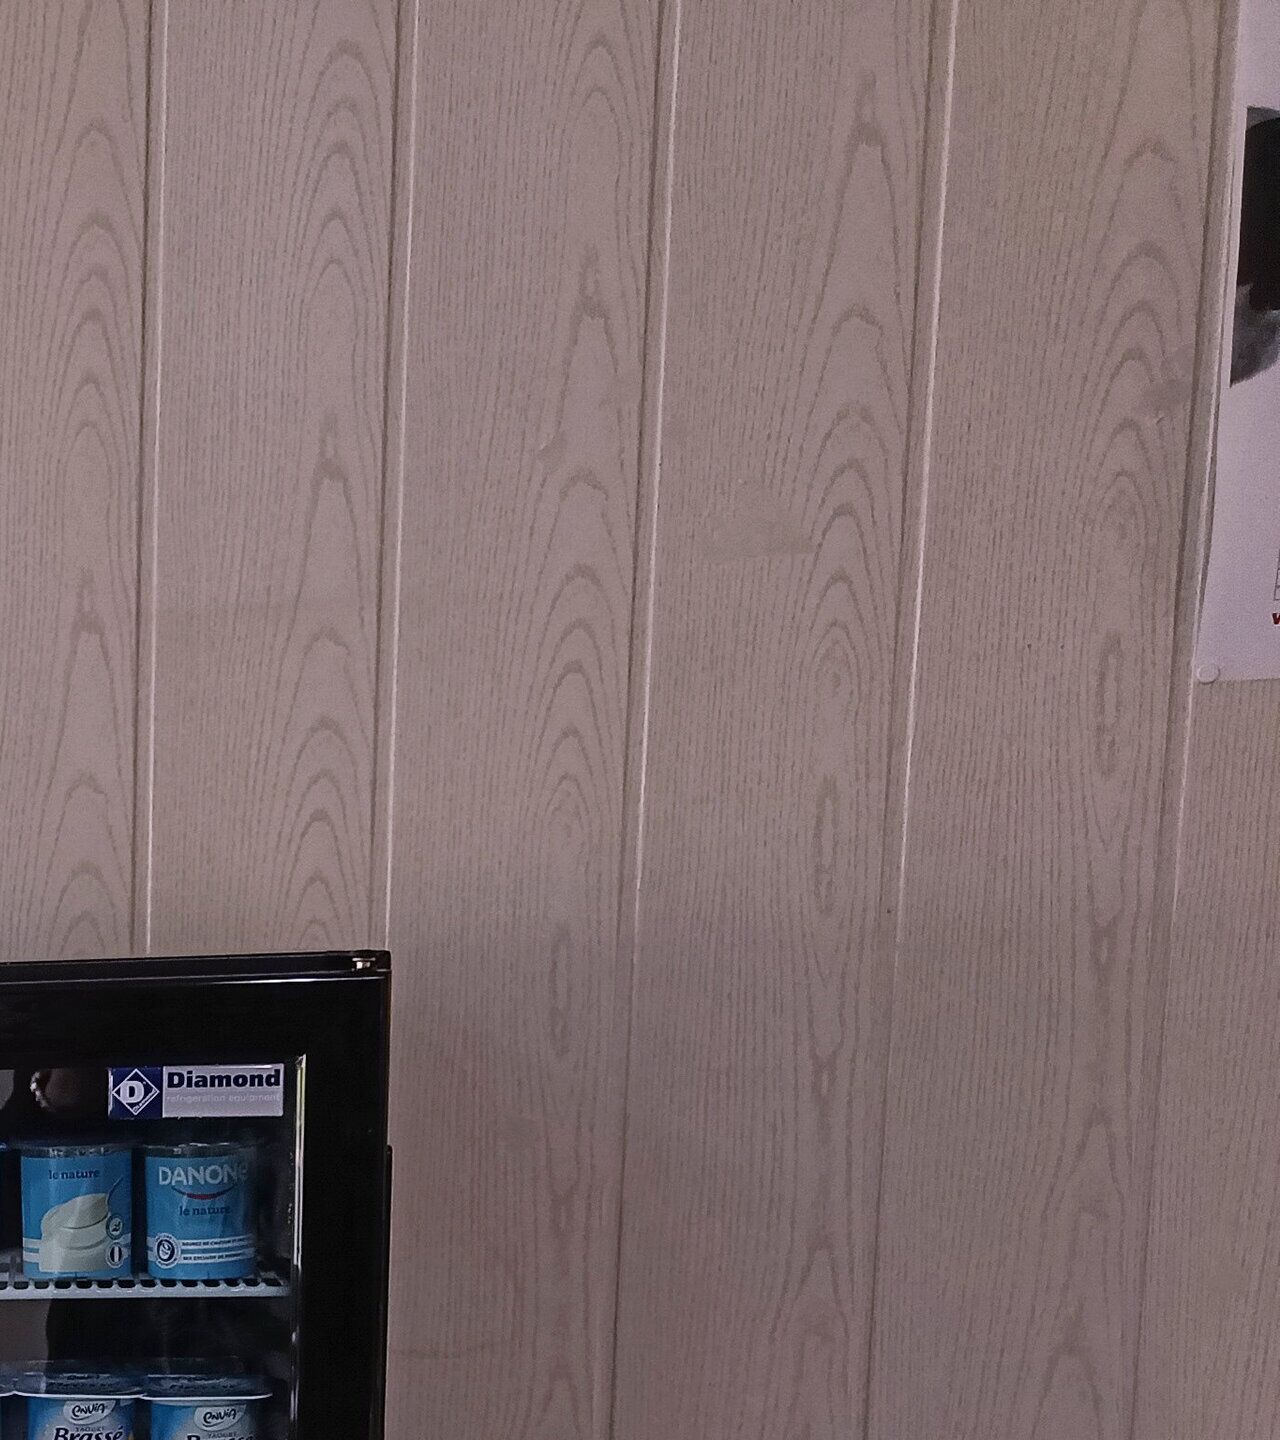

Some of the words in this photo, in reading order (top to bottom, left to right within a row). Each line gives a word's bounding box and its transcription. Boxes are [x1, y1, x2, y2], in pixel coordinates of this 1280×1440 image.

[167, 1069, 281, 1088] Diamond
[48, 1169, 58, 1180] le
[61, 1168, 100, 1180] nature
[179, 1205, 189, 1216] le
[193, 1205, 231, 1215] nature
